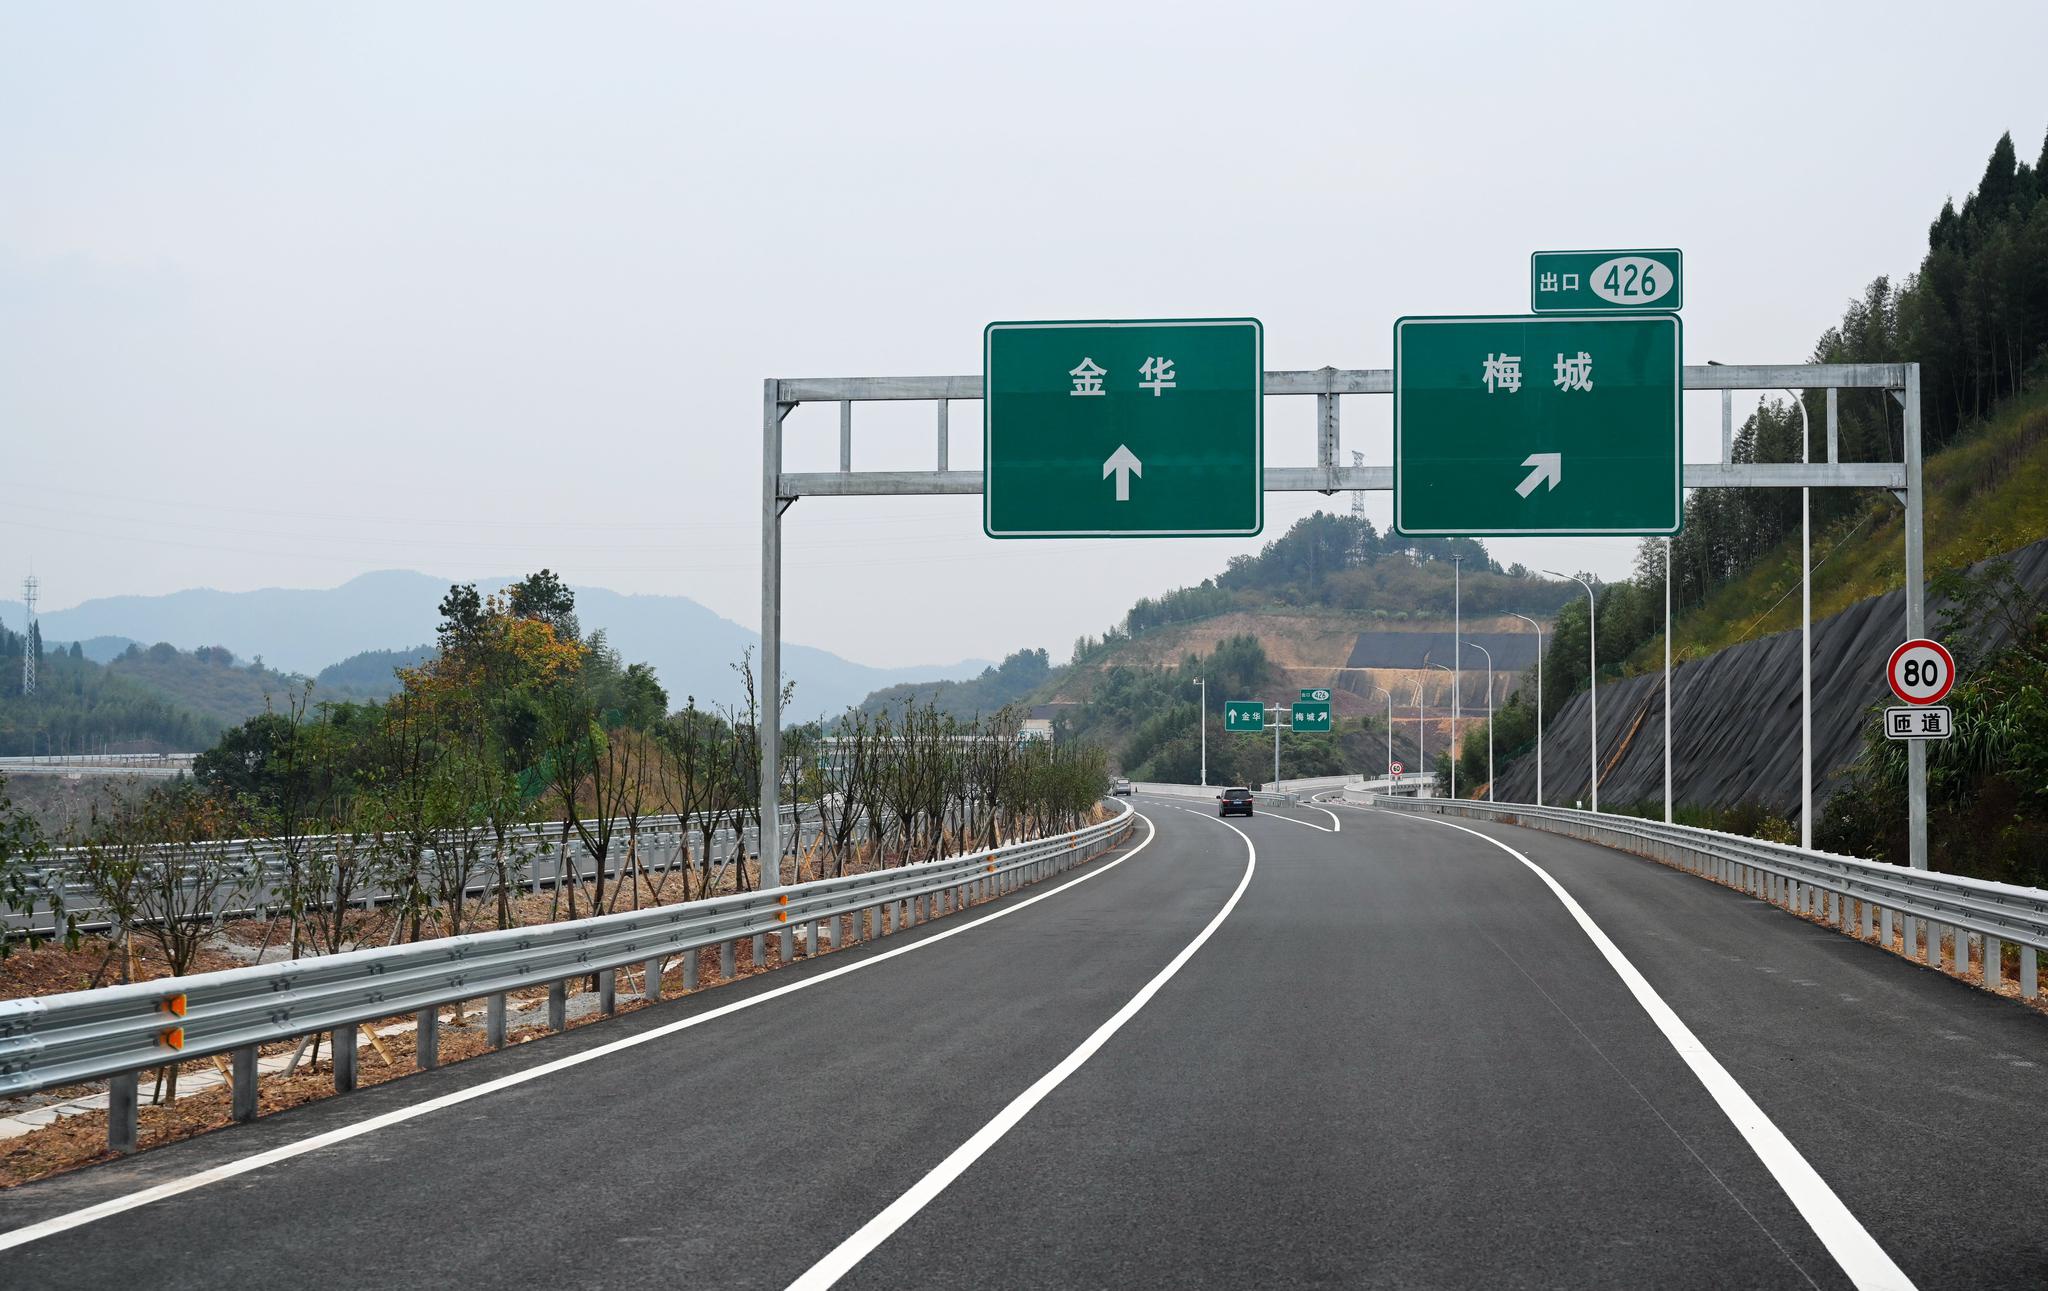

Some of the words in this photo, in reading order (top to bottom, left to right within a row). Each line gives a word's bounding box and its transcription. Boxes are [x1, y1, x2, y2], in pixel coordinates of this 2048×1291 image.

[1539, 271, 1580, 293] 出口
[1603, 263, 1657, 298] 426
[1068, 356, 1178, 398] 金华
[1482, 351, 1594, 394] 梅城
[1904, 659, 1938, 687] 80
[1314, 691, 1327, 699] 426
[1241, 711, 1261, 721] 金华
[1295, 711, 1315, 721] 梅城
[1894, 712, 1942, 733] 匝道
